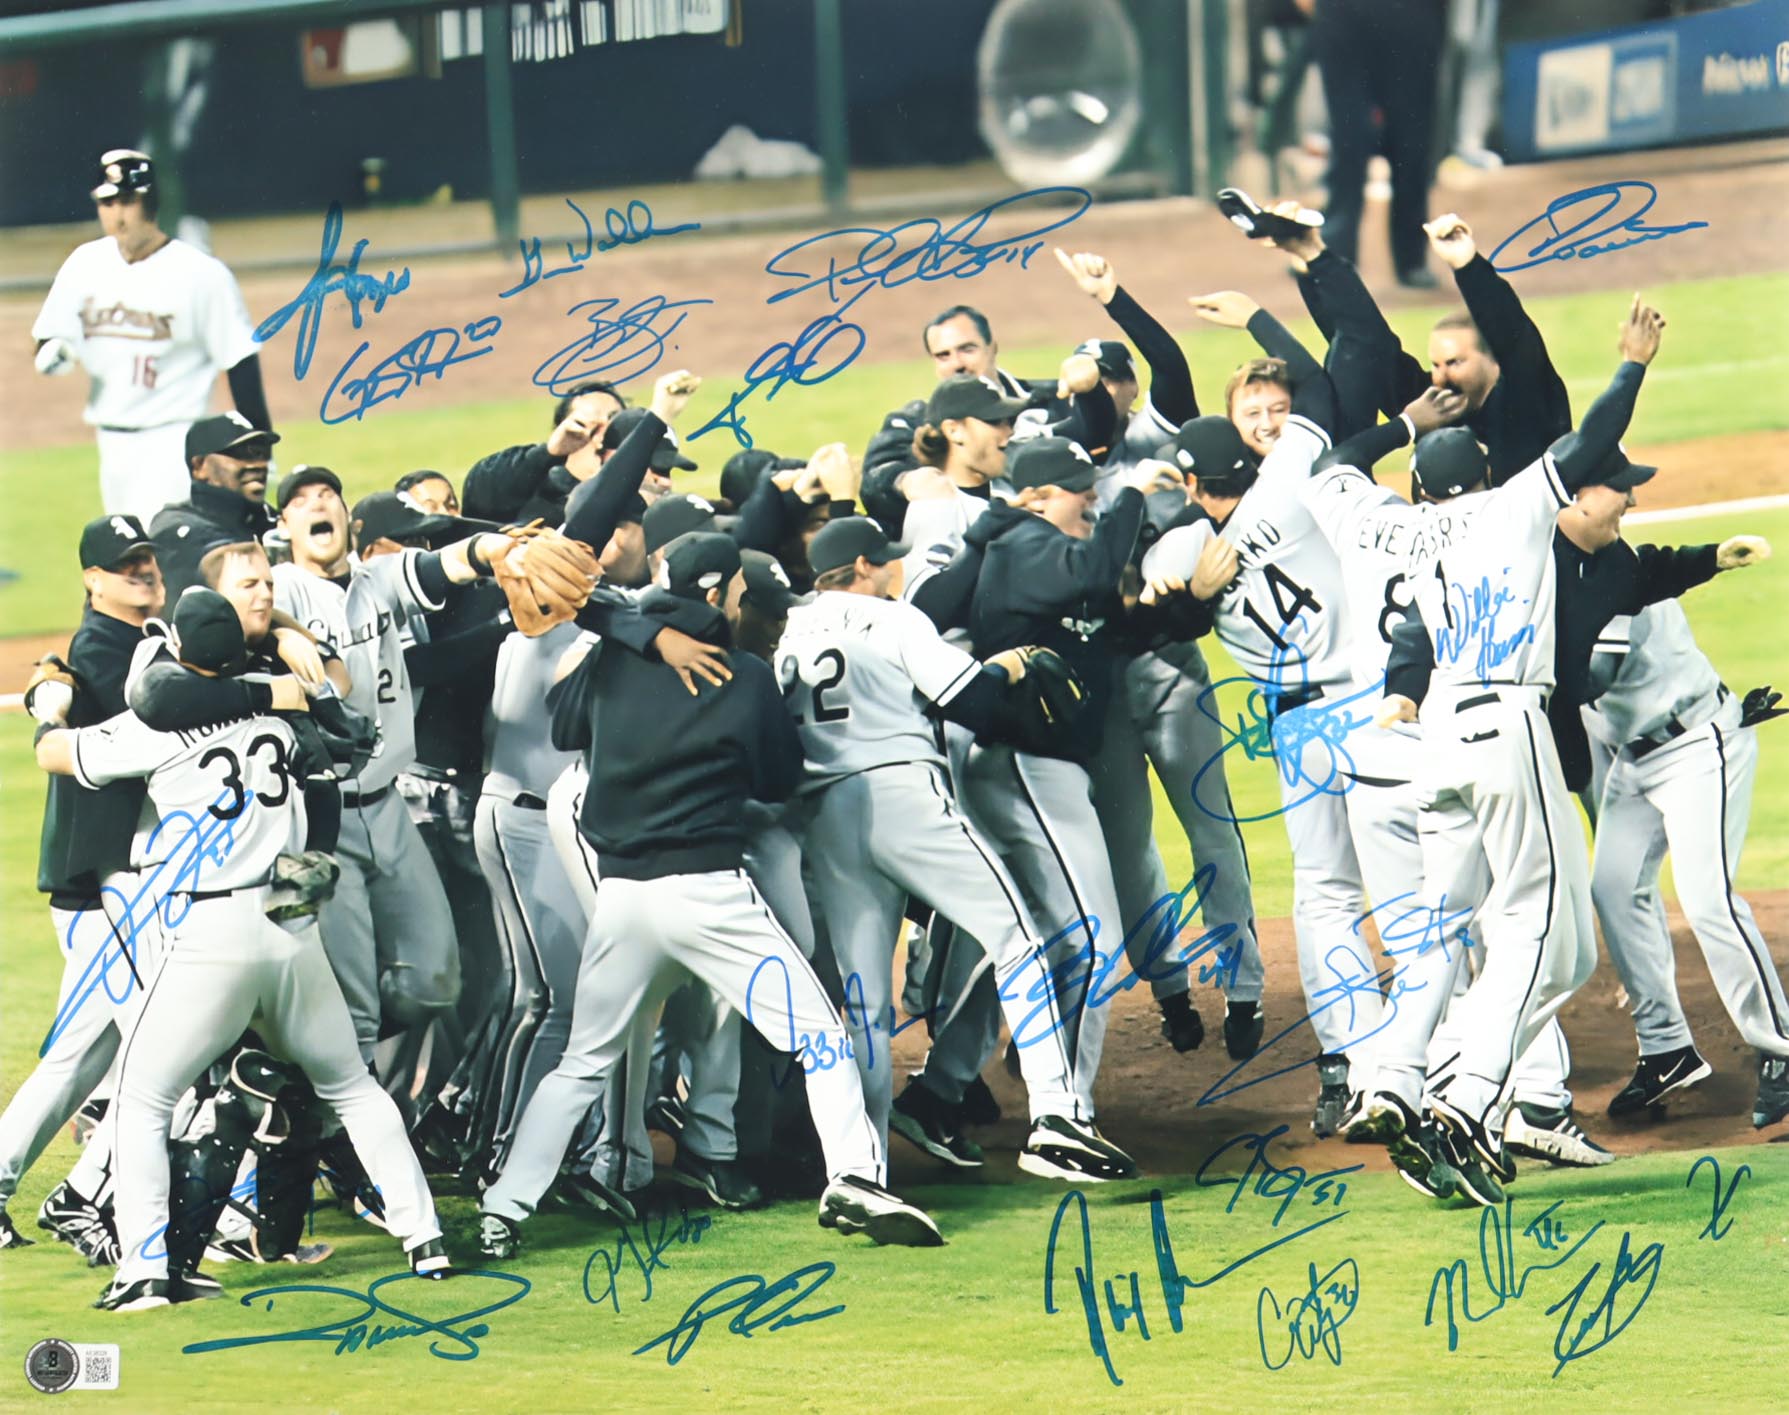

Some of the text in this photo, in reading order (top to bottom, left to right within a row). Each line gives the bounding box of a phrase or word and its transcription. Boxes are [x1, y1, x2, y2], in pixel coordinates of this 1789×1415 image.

[132, 355, 158, 388] 16
[1243, 562, 1322, 651] 14
[1435, 559, 1454, 630] 1
[377, 668, 397, 704] 2
[198, 733, 290, 821] 33
